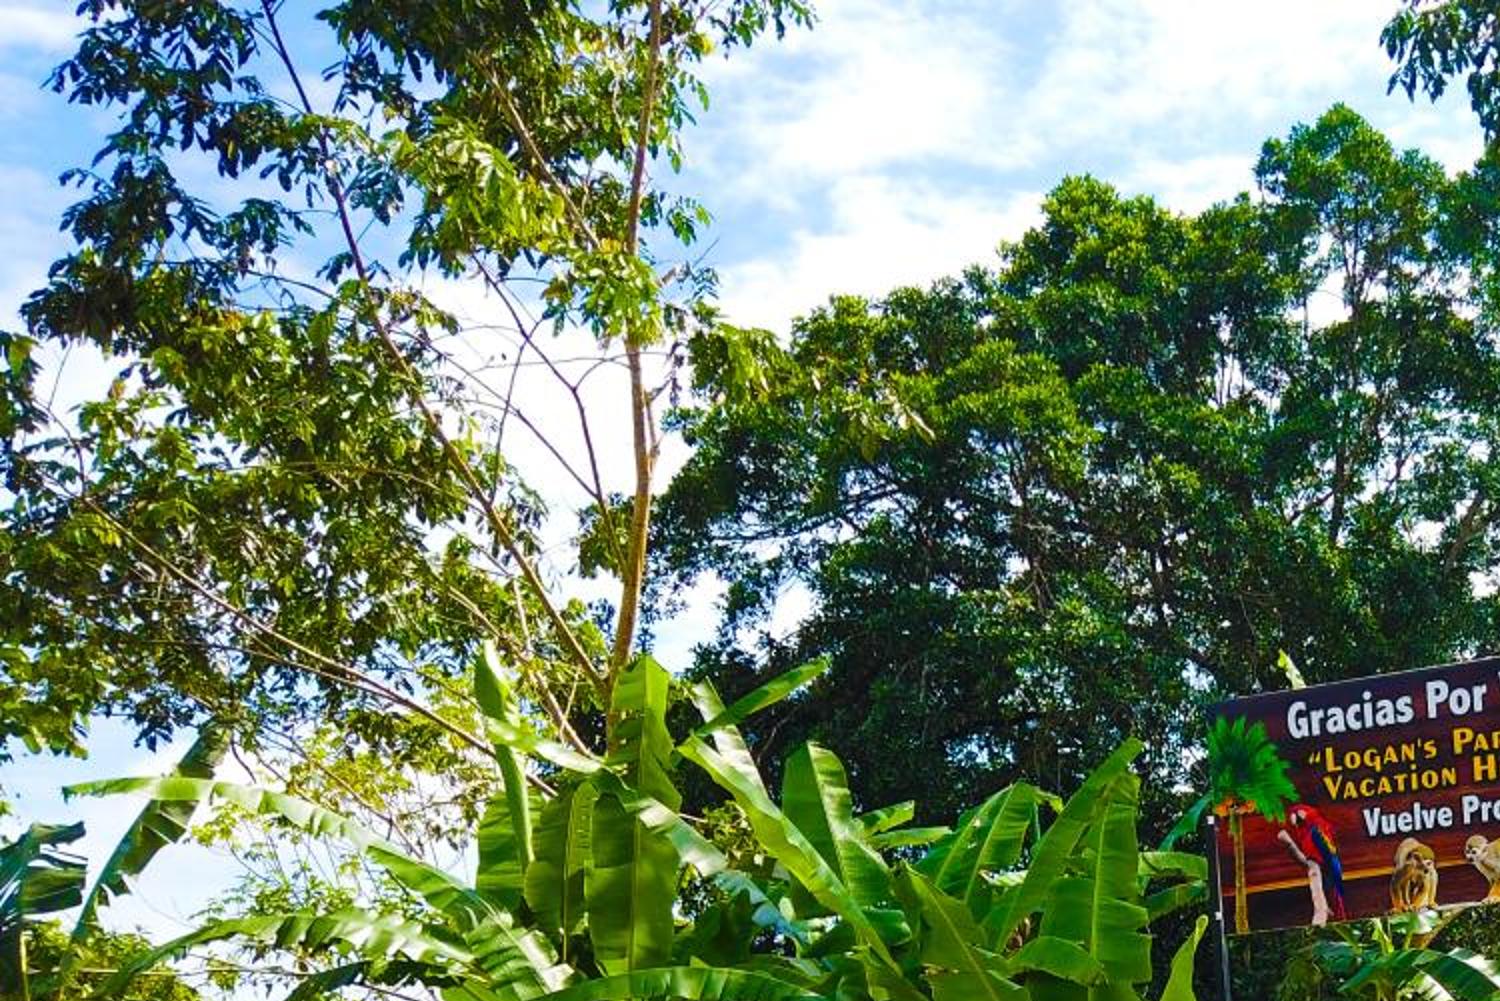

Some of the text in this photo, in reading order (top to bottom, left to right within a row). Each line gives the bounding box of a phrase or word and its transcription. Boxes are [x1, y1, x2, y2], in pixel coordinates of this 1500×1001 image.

[1287, 691, 1415, 739] Gracias
[1425, 680, 1486, 719] Por
[1363, 801, 1452, 837] Vuelve
